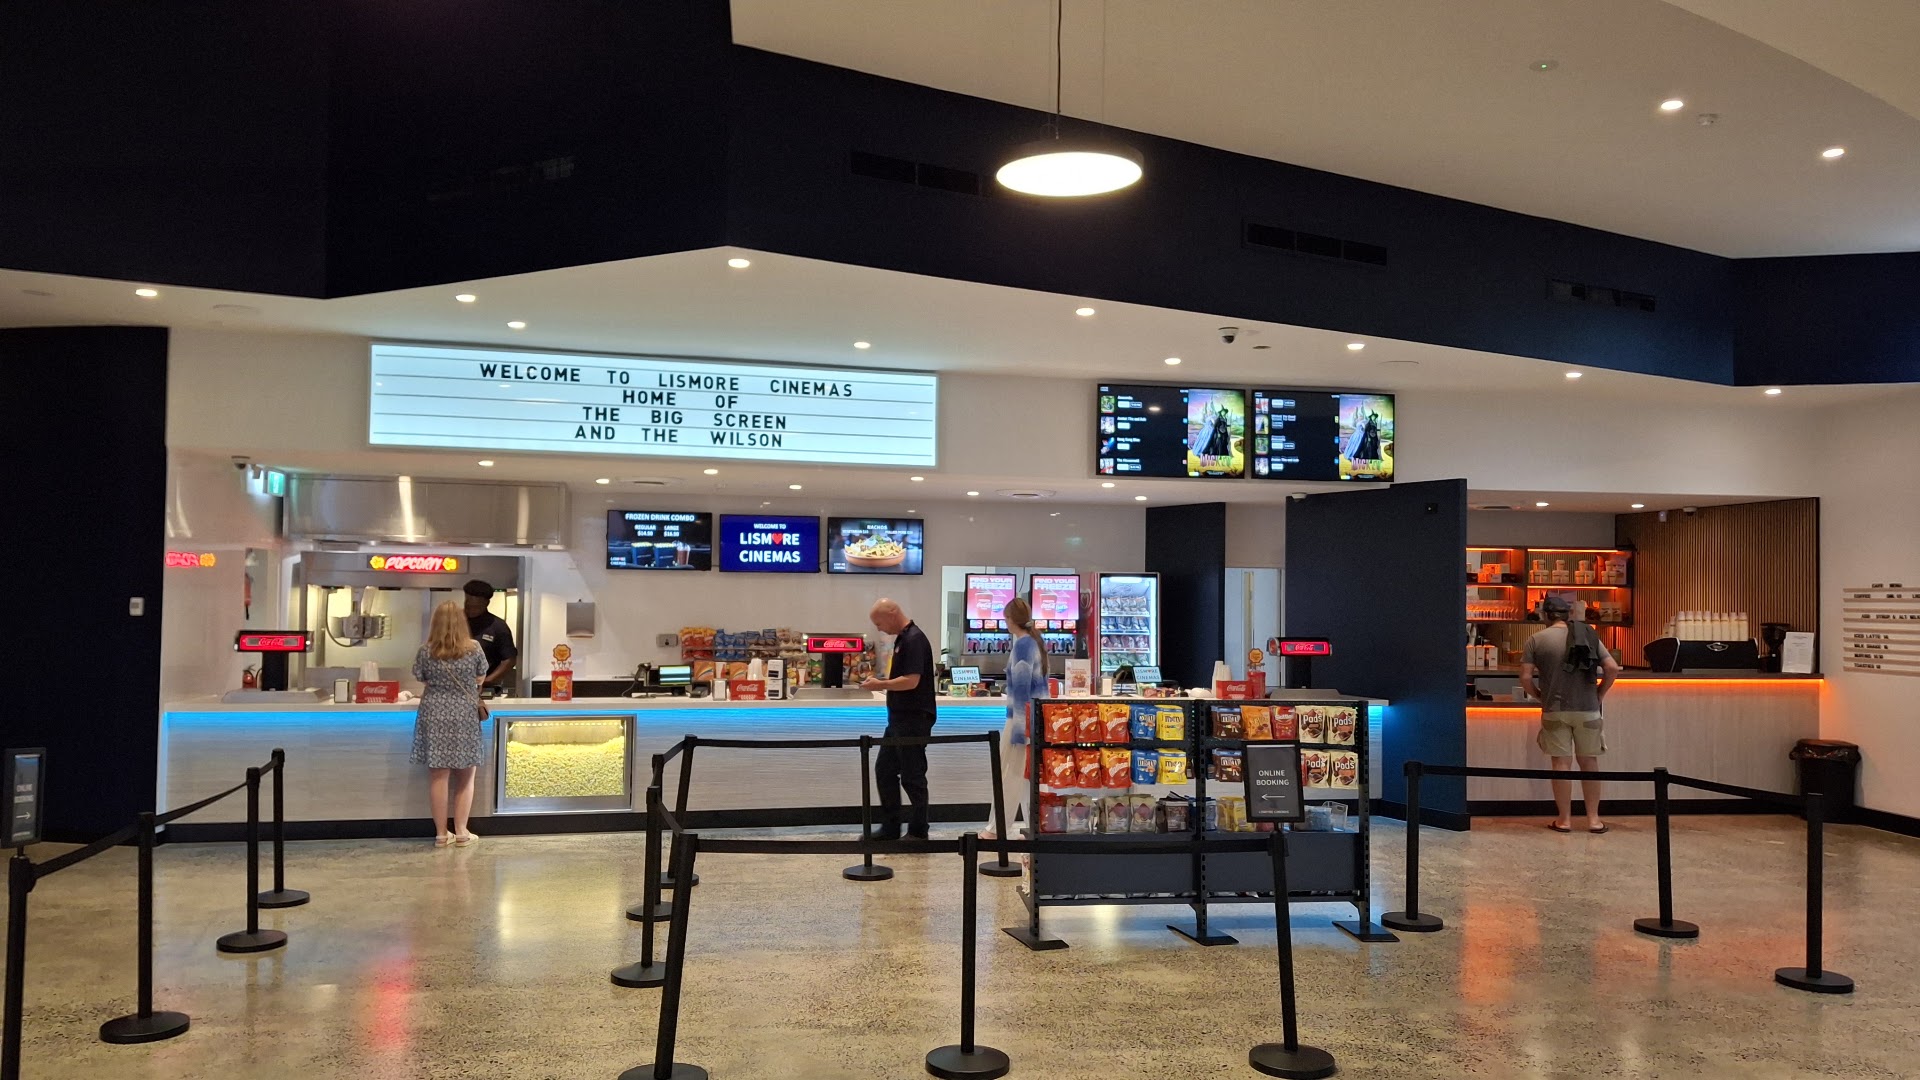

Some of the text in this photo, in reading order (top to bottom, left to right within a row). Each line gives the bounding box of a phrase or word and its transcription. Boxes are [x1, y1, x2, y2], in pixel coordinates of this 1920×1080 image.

[480, 363, 853, 397] WELCOME TO LISMORE CINEMAS
[622, 390, 738, 409] HOME OF
[583, 406, 786, 429] THE BIG SCREEN
[575, 425, 782, 447] AND THE WILSON
[625, 513, 695, 522] FROZEN DRINK COMBO
[385, 556, 443, 570] POPCORN
[739, 550, 801, 563] CINEMAS
[1303, 713, 1323, 724] Pods
[1333, 716, 1353, 727] Pods
[1335, 760, 1355, 770] Pods
